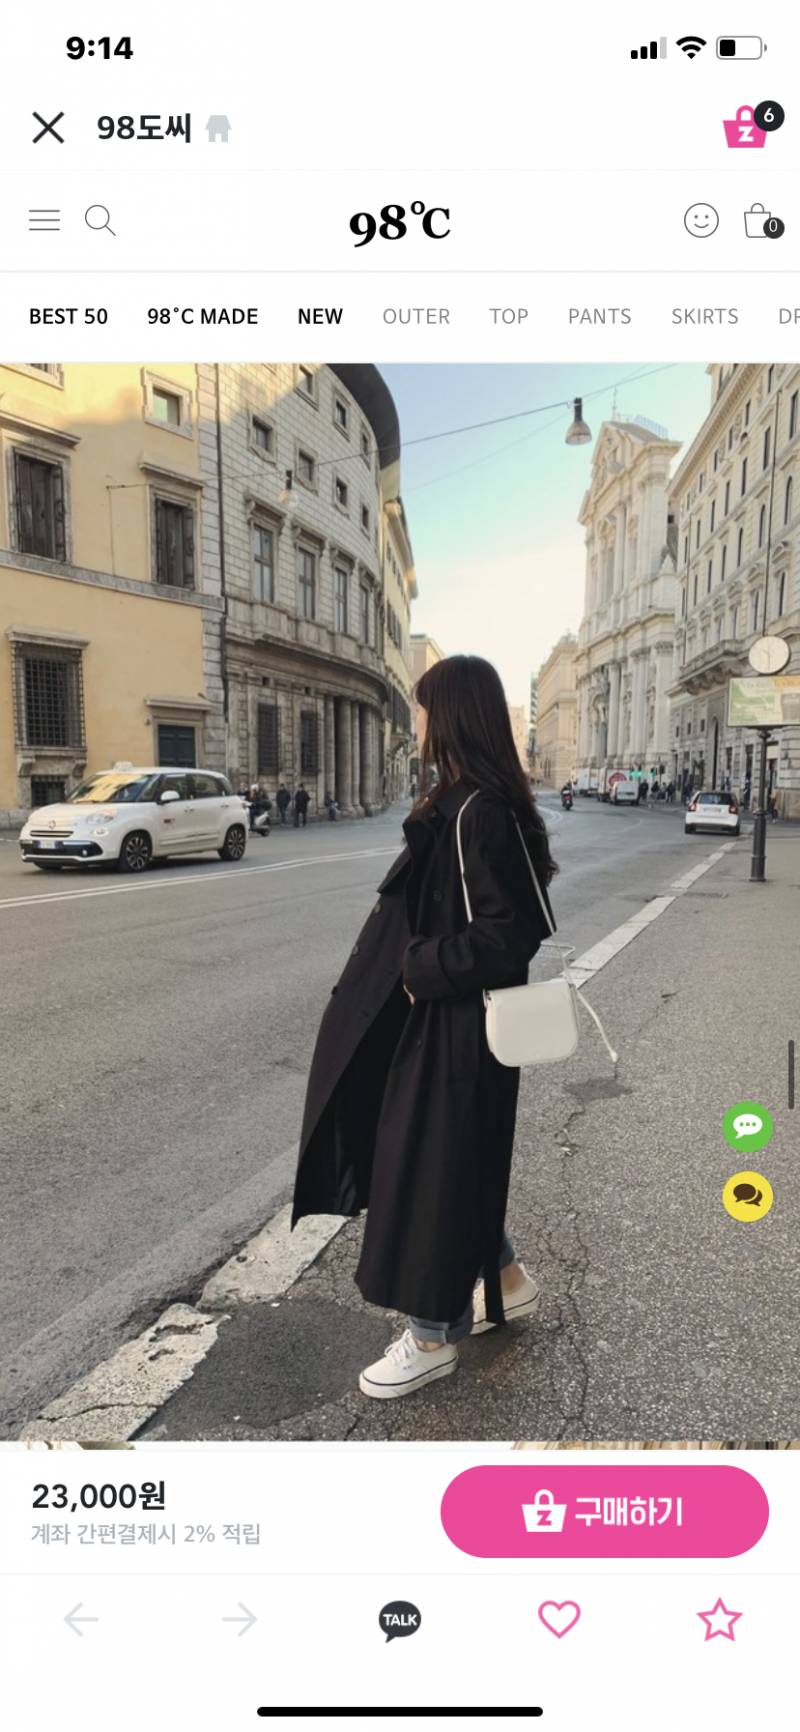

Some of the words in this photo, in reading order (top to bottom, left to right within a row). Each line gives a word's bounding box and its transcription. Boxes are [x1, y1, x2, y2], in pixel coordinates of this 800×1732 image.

[66, 36, 134, 60] 9:14
[764, 107, 774, 122] 6
[97, 113, 191, 143] 98도씨
[349, 201, 451, 248] 98°C
[769, 219, 778, 232] 0
[29, 308, 78, 324] BEST
[84, 308, 108, 324] 50
[201, 308, 258, 324] MADE
[298, 308, 343, 324] NEW
[382, 308, 450, 324] OUTER
[489, 308, 529, 324] TOP
[568, 308, 632, 324] PANTS
[671, 308, 739, 324] SKIRTS
[32, 1480, 166, 1513] 23,000원
[575, 1496, 682, 1526] 구매하기
[31, 1524, 70, 1545] 계좌
[77, 1524, 176, 1545] 간편결제시
[184, 1525, 216, 1542] 2%
[222, 1524, 261, 1545] 적립
[382, 1613, 418, 1627] TALK
